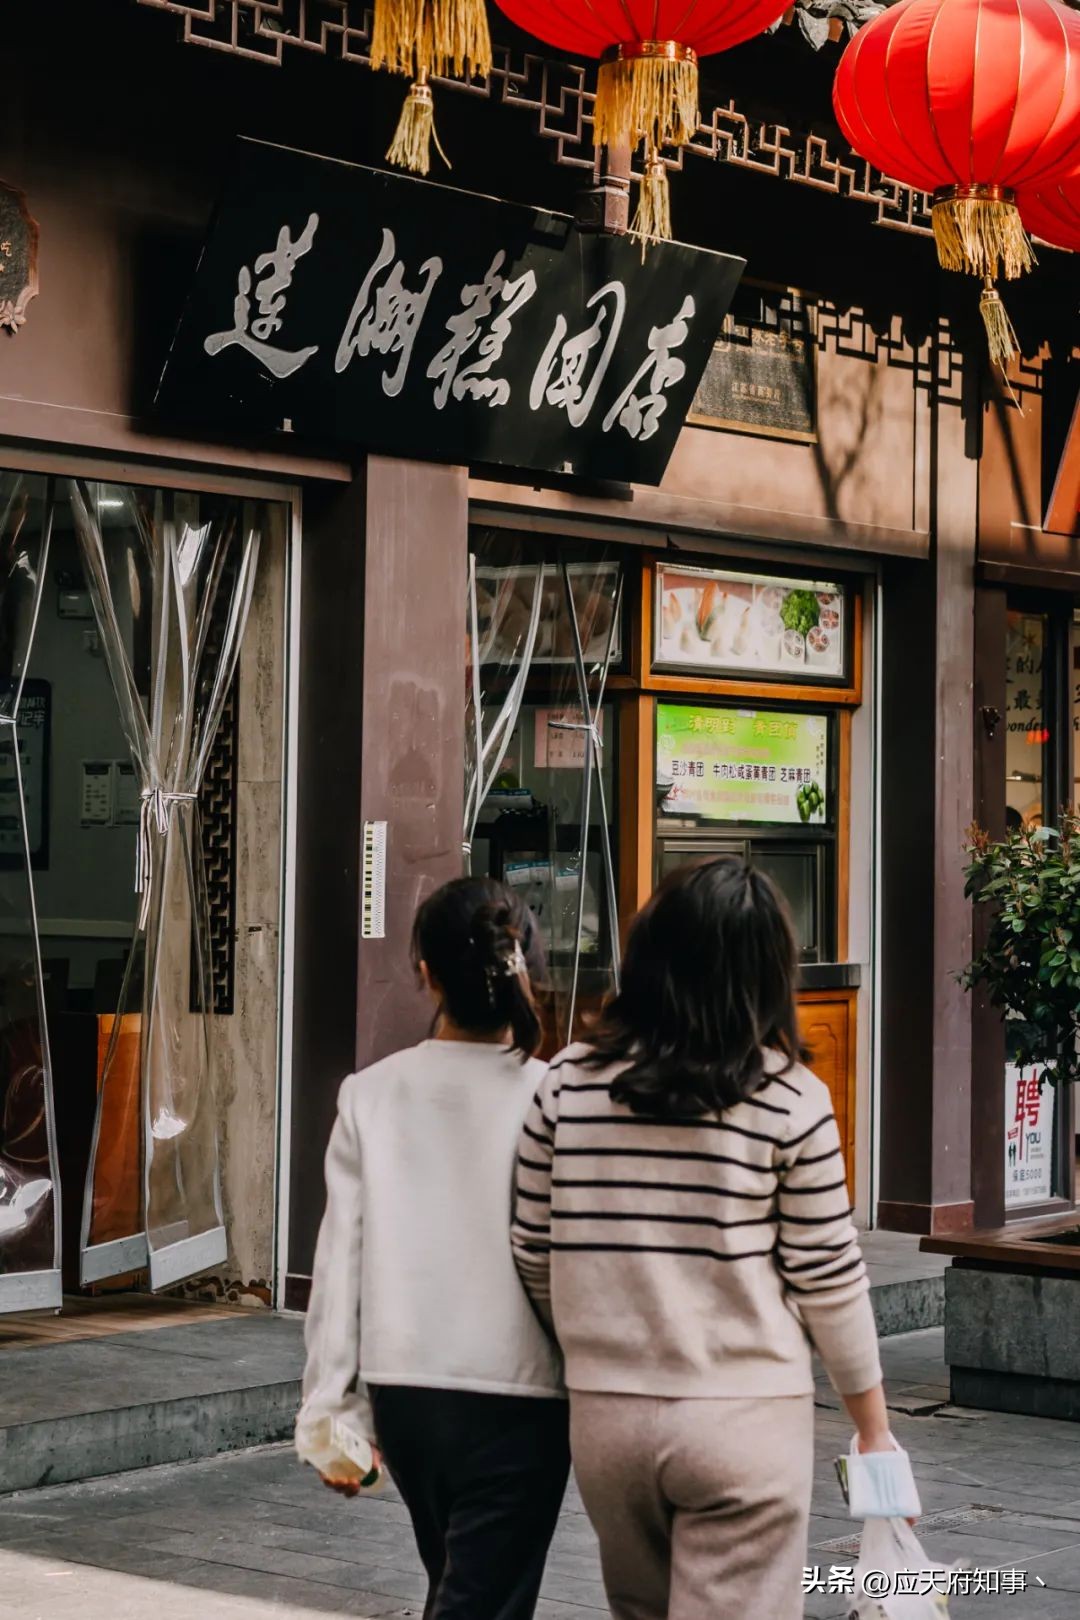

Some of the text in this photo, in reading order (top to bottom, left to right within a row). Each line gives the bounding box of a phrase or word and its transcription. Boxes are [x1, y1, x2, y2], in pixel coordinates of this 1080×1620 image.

[671, 760, 811, 783] 豆沙青团 牛肉松咸蛋黄青团 芝麻青团
[1015, 1068, 1041, 1161] 聘
